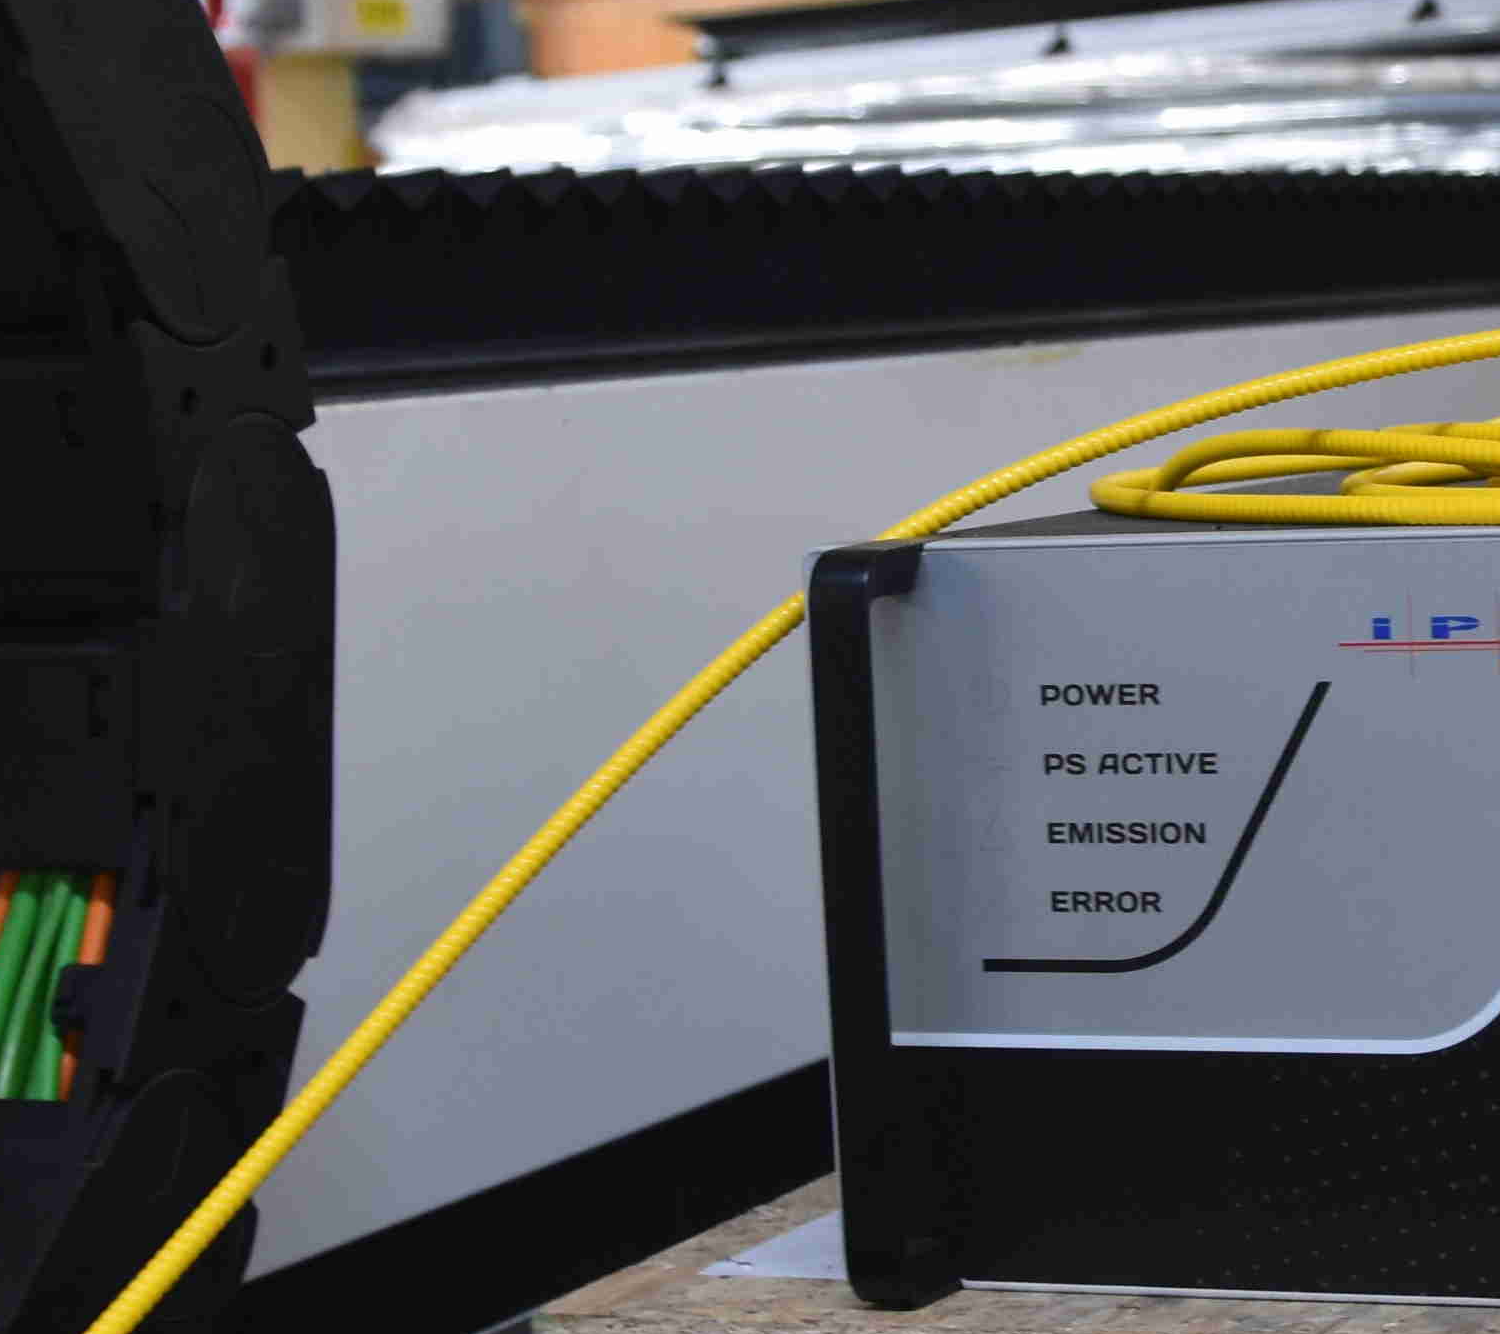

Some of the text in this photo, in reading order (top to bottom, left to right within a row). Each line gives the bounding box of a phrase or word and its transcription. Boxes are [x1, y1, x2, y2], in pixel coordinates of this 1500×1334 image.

[1040, 682, 1161, 707] POWER
[1044, 751, 1219, 776] PS ACTIVE
[1046, 821, 1207, 845] EMISSION
[1050, 890, 1162, 914] ERROR
